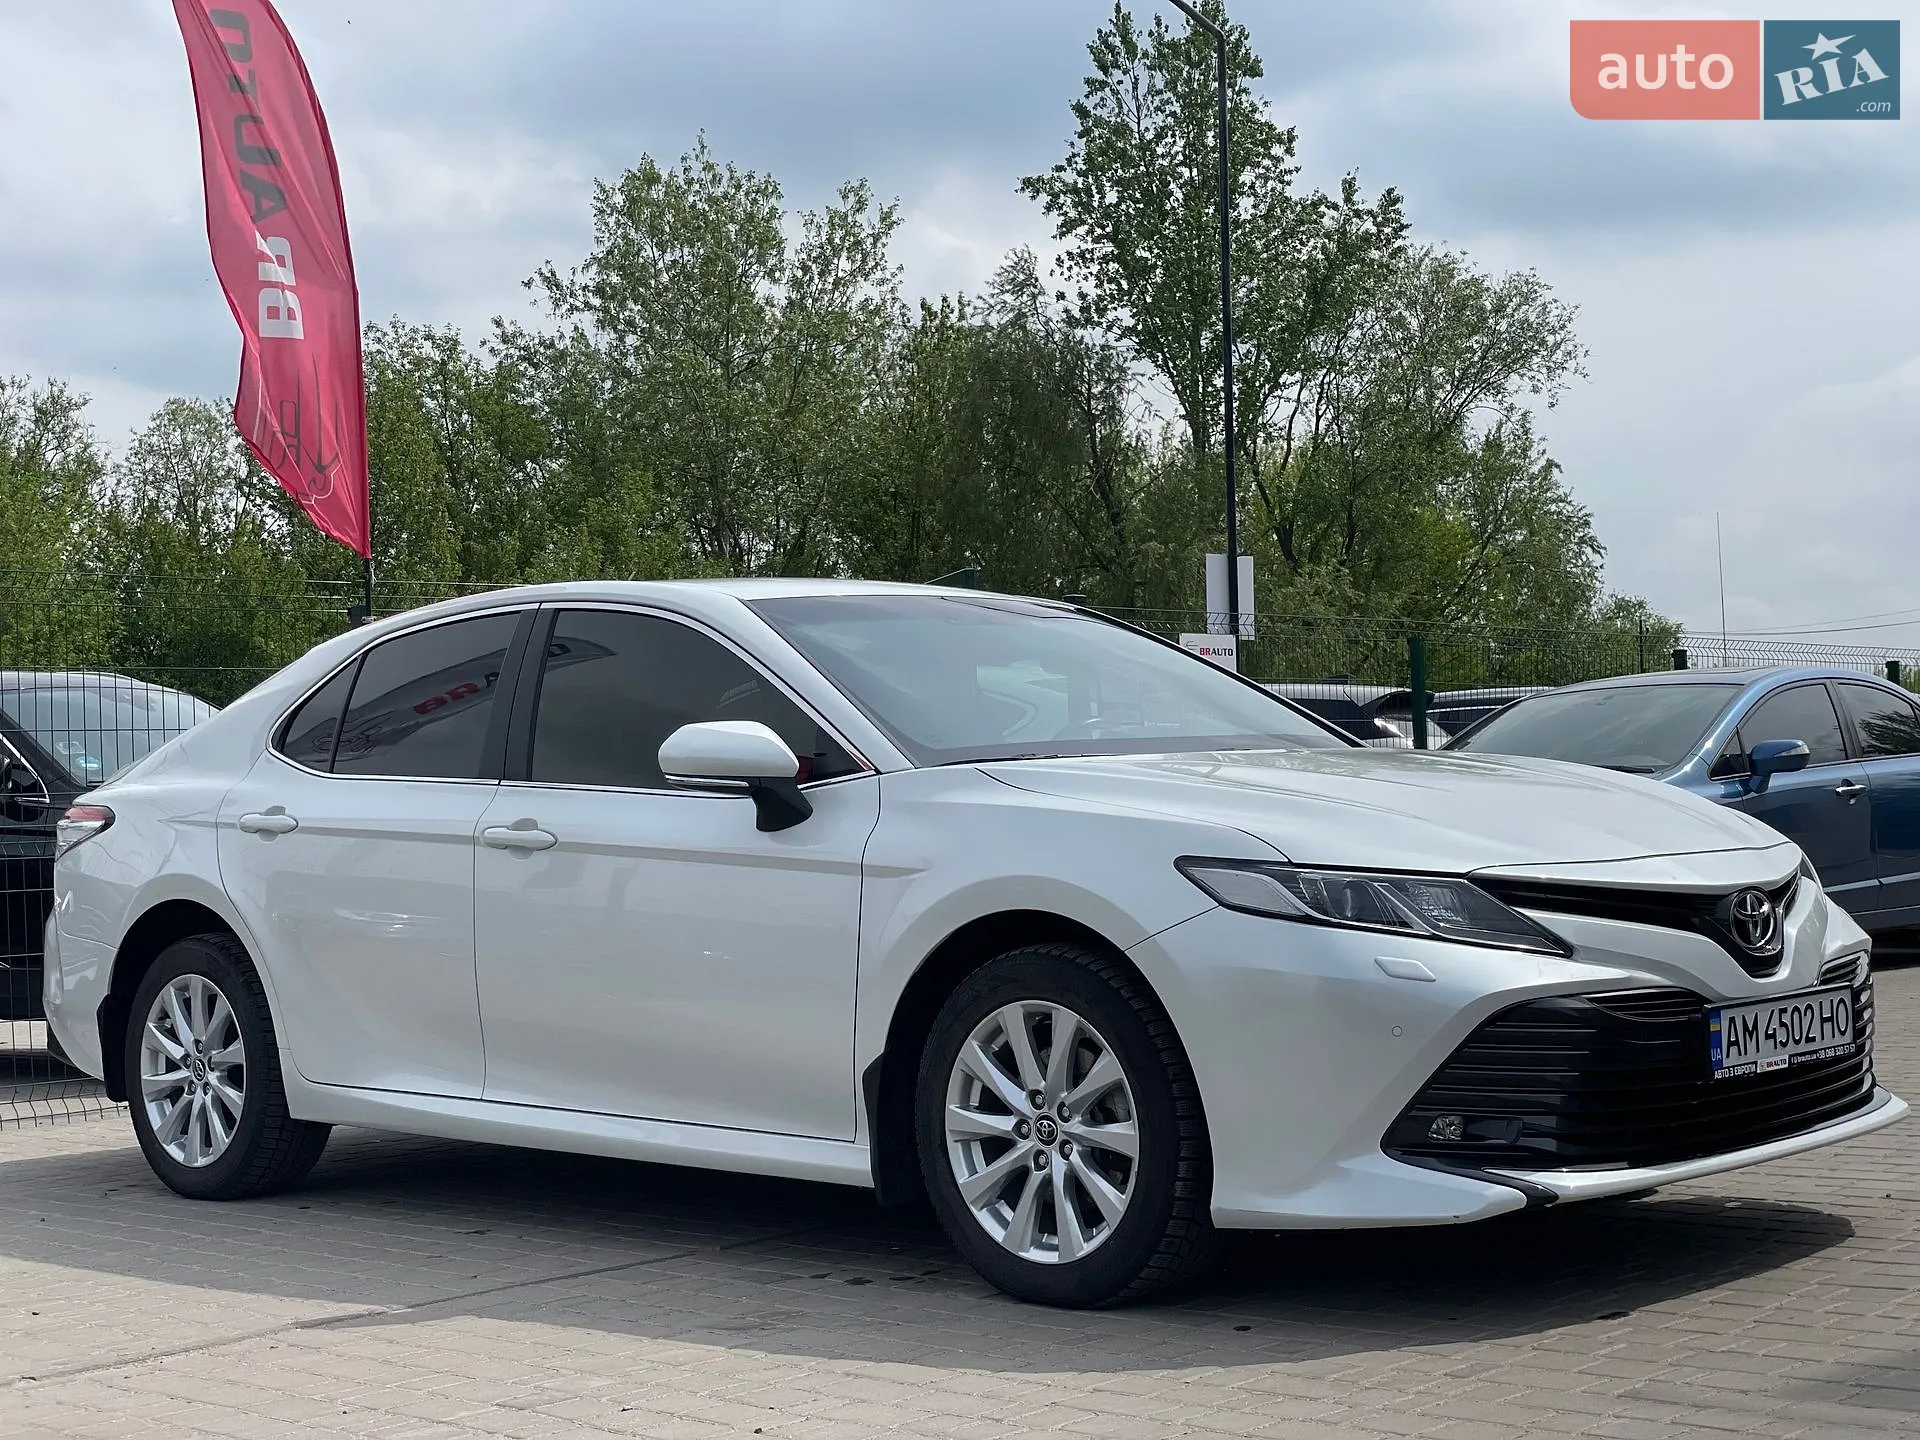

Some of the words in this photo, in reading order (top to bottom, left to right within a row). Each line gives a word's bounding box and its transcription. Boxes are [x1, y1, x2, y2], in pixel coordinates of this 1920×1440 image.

[1199, 648, 1233, 656] BRAUTO
[1726, 1012, 1759, 1058] AM
[1764, 1002, 1817, 1050] 4502
[1819, 997, 1849, 1041] HO
[1711, 1047, 1723, 1061] UA
[1766, 1058, 1787, 1069] BRAUTO
